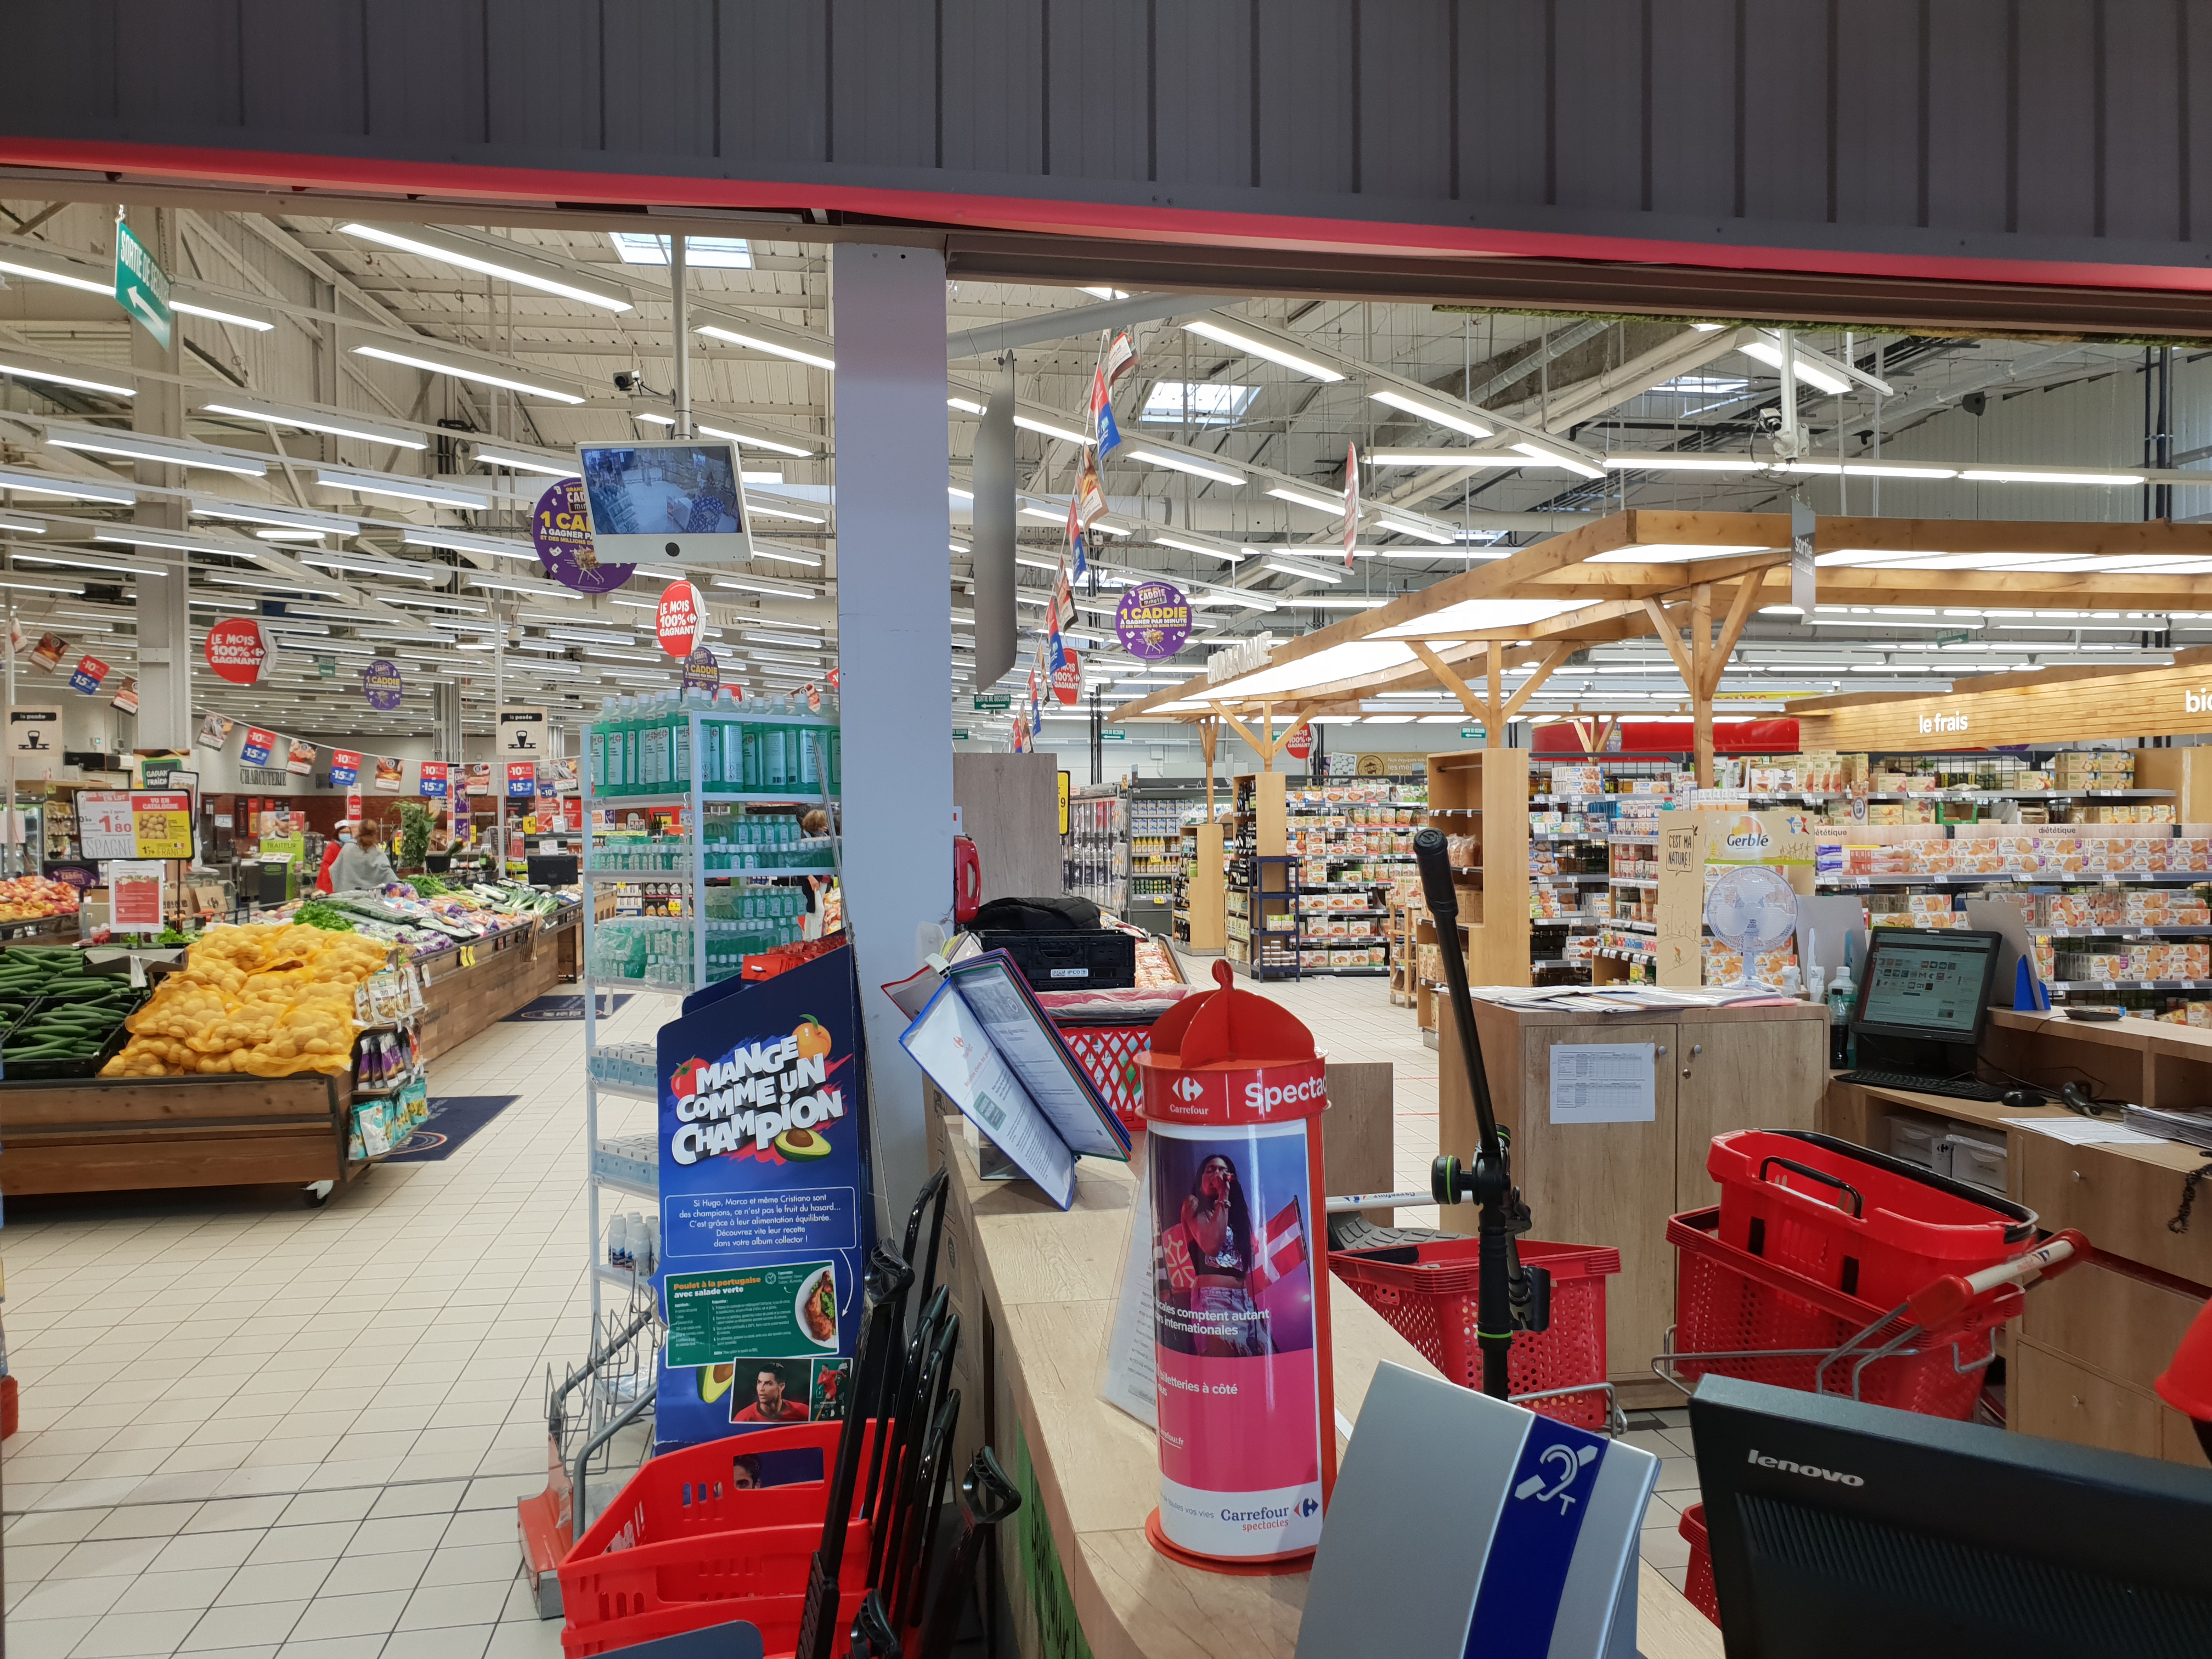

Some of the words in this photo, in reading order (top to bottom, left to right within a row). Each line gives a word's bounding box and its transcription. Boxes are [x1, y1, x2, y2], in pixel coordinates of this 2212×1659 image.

[121, 230, 143, 279] SORTIE
[143, 253, 151, 287] DE
[540, 511, 551, 527] 1
[556, 513, 591, 532] CA
[540, 526, 547, 535] À
[549, 528, 583, 539] GAGNER
[560, 537, 586, 545] MILLIONS
[1795, 536, 1813, 561] sortie
[1139, 588, 1165, 601] CADDIE
[660, 602, 668, 616] LE
[669, 600, 690, 614] MOIS
[1120, 608, 1128, 620] 1
[1131, 607, 1187, 620] CADDIE
[660, 613, 686, 628] 100%
[659, 625, 695, 637] GAGNANT
[211, 634, 222, 645] LE
[225, 634, 255, 646] MOIS
[211, 645, 250, 657] 100%
[211, 656, 261, 665] GAGNANT
[685, 664, 689, 672] 1
[691, 665, 718, 675] CADDIE
[371, 676, 400, 686] CADDIE
[1054, 672, 1073, 682] 100%
[1054, 681, 1079, 690] GAGNANT
[1919, 714, 1932, 733] le
[1934, 710, 1968, 732] frais
[239, 769, 286, 786] CHARCUTERIE
[2038, 826, 2076, 834] diététique
[1668, 834, 1681, 848] C'EST
[1684, 834, 1692, 849] MA
[1727, 834, 1769, 848] Gerblé
[696, 1035, 799, 1094] MANGE
[676, 1076, 776, 1122] COMME
[1170, 1104, 1209, 1115] Carrefour
[702, 1199, 723, 1208] Hugo,
[780, 1194, 810, 1203] Cristiano
[693, 1209, 732, 1220] champions,
[785, 1205, 798, 1213] fruit
[810, 1202, 841, 1211] hasard...
[689, 1220, 706, 1228] C'est
[708, 1219, 728, 1229] grâce
[752, 1215, 793, 1224] alimentation
[795, 1213, 832, 1223] équilibrée.
[716, 1227, 752, 1237] Découvrez
[714, 1239, 731, 1247] dans
[752, 1237, 773, 1245] album
[775, 1235, 803, 1244] collector
[717, 1276, 761, 1288] portugaise
[695, 1287, 721, 1296] salade
[723, 1285, 744, 1294] verte
[1177, 1308, 1229, 1322] comptent
[1232, 1308, 1269, 1322] autant
[1164, 1314, 1239, 1335] internationales
[1160, 1370, 1200, 1392] billetteries
[1202, 1382, 1210, 1394] à
[1212, 1383, 1238, 1395] côté
[1747, 1449, 1864, 1487] lenovo
[1168, 1498, 1183, 1511] toutes
[1199, 1509, 1214, 1519] vies
[1221, 1506, 1289, 1521] Carrefour
[1242, 1519, 1289, 1532] spectacles
